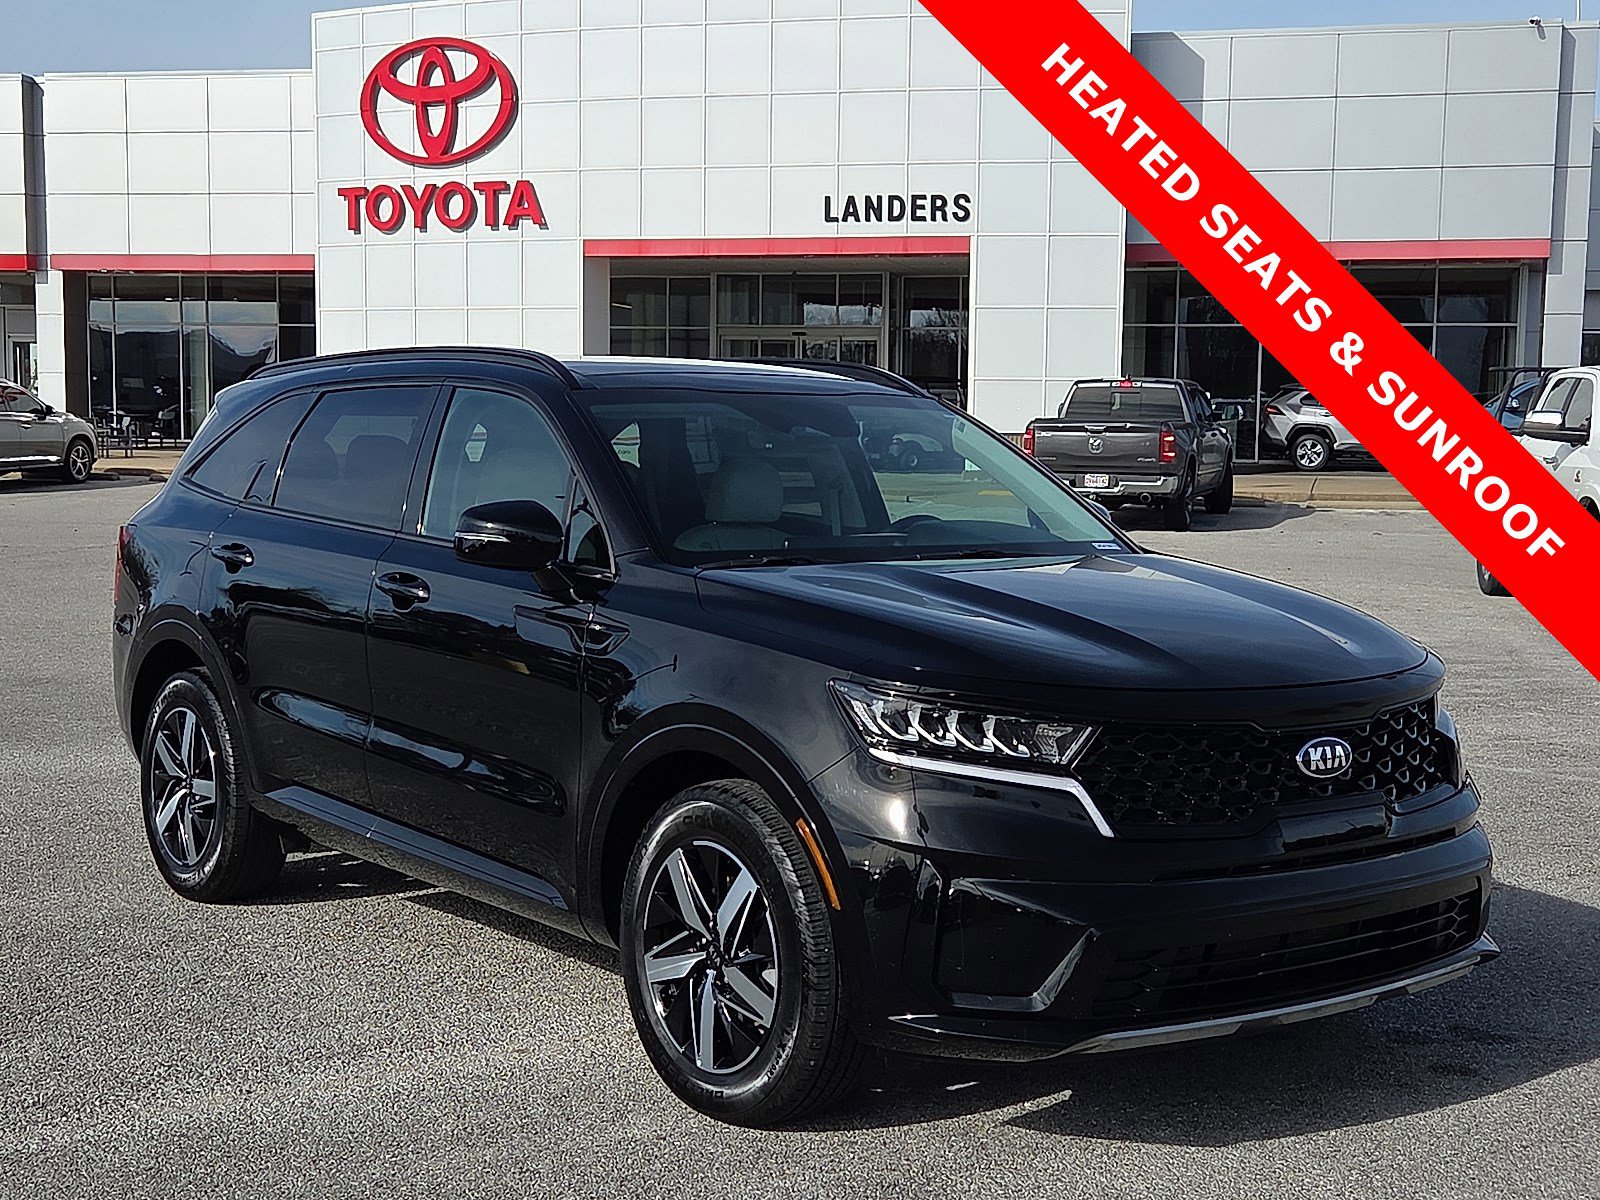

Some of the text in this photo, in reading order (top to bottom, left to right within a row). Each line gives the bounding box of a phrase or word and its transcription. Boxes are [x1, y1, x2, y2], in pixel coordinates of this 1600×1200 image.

[338, 180, 548, 233] TOYOTA
[824, 193, 971, 223] LANDERS
[1308, 745, 1347, 771] KIA
